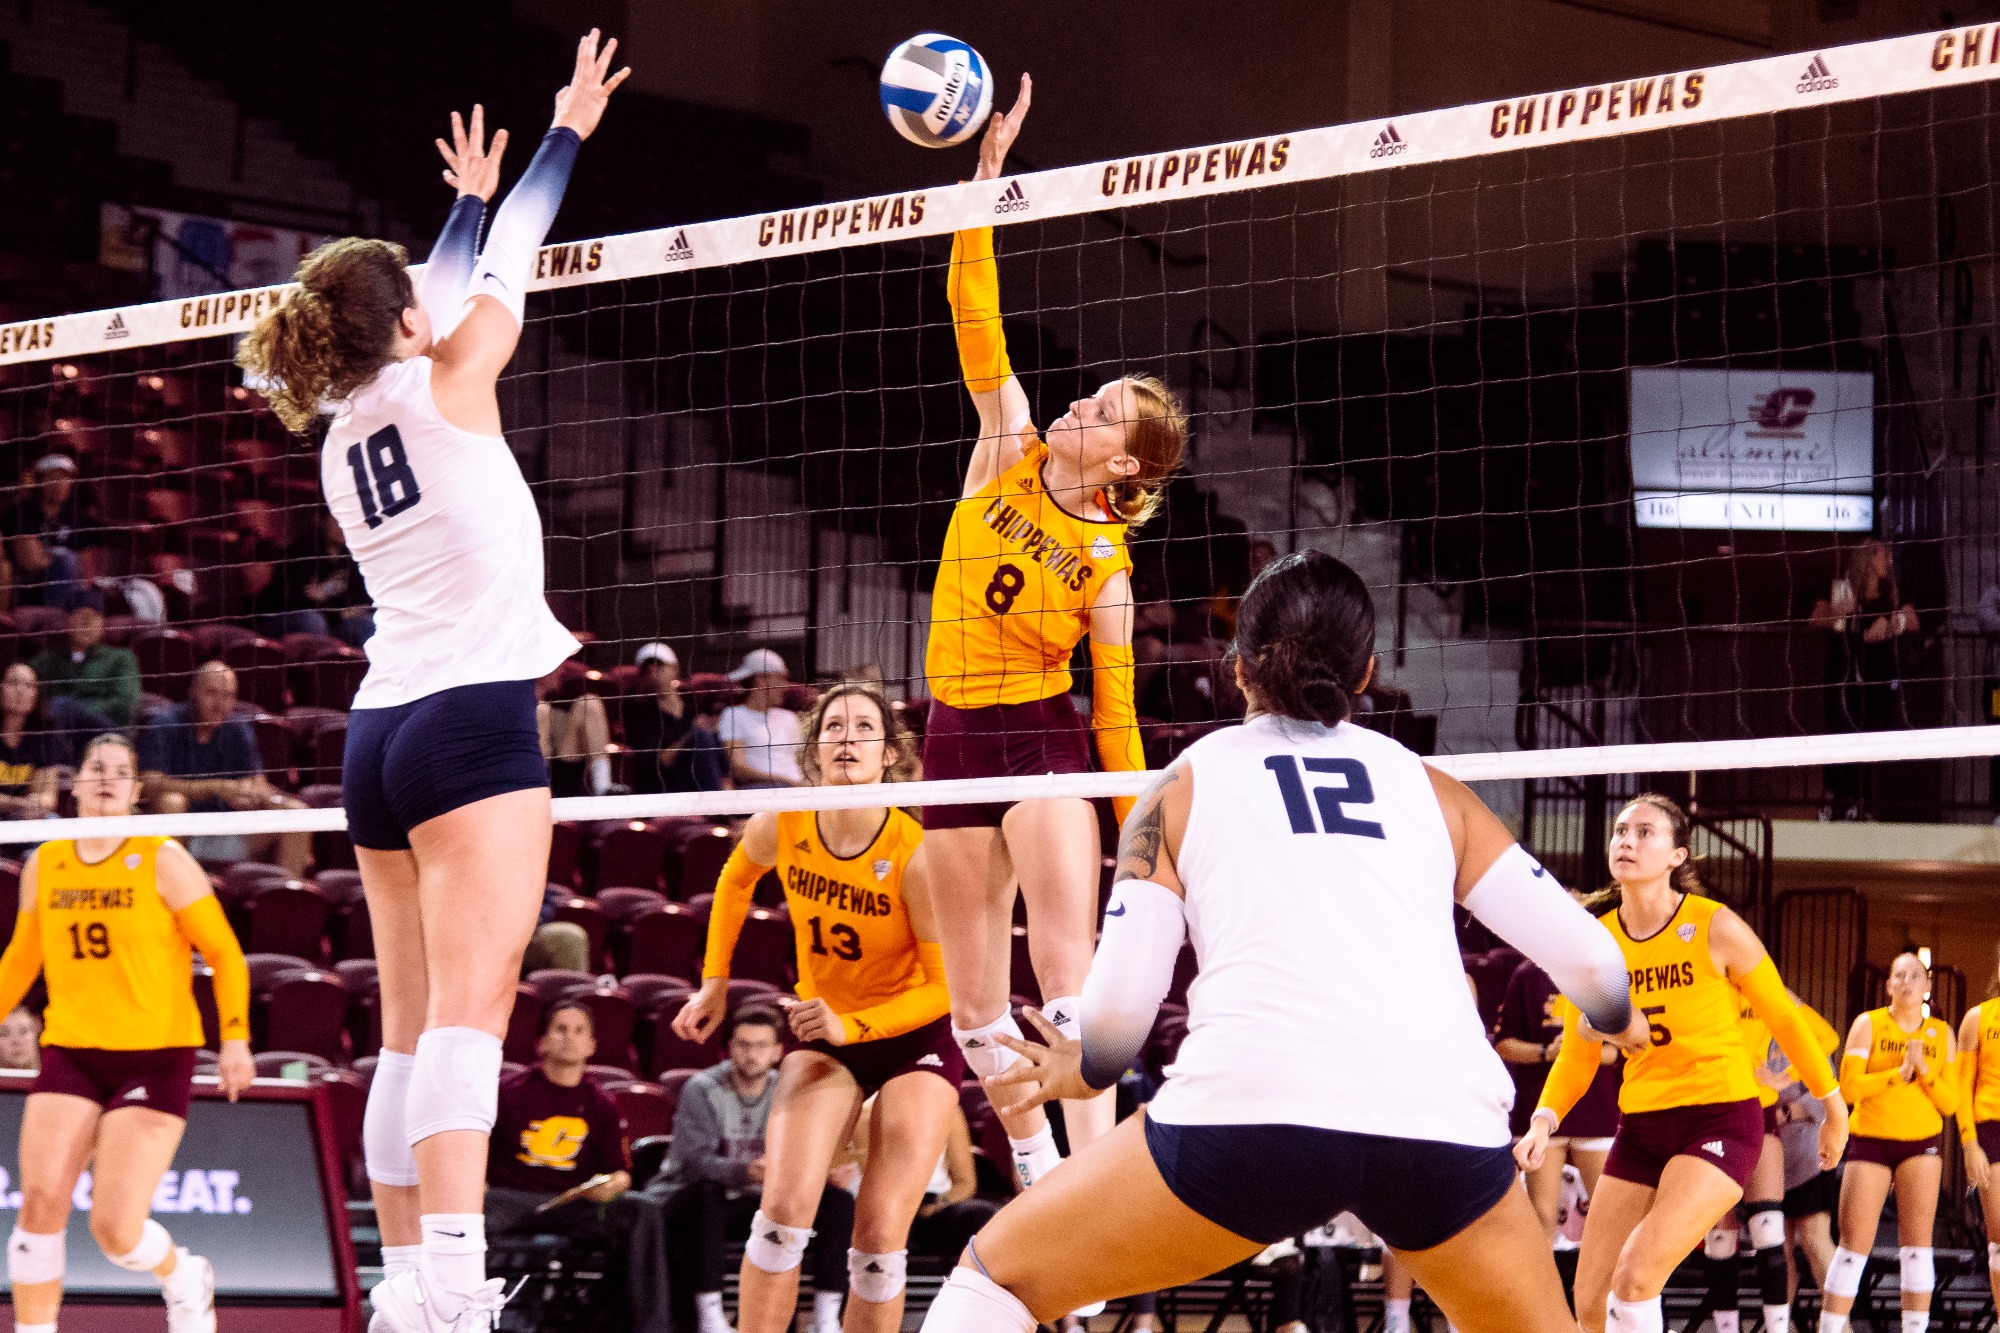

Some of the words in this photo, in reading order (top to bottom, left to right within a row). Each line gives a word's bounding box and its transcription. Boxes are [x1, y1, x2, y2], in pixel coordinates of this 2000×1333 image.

[1931, 25, 2000, 72] CHI
[935, 62, 965, 121] molten
[1489, 71, 1705, 139] CHIPPEWAS
[1796, 78, 1839, 93] adidas
[1102, 137, 1291, 197] CHIPPEWAS
[1370, 142, 1408, 158] adidas
[758, 192, 926, 248] CHIPPEWAS
[994, 200, 1029, 214] adidas
[531, 241, 604, 280] EWAS
[664, 248, 694, 262] adidas
[347, 423, 421, 530] 18
[983, 496, 1093, 593] CHIPPEWAS
[984, 563, 1025, 615] 8
[1264, 754, 1387, 840] 12
[787, 864, 892, 917] CHIPPEWAS
[68, 921, 113, 961] 19
[807, 915, 864, 962] 13
[1640, 1004, 1673, 1048] 5
